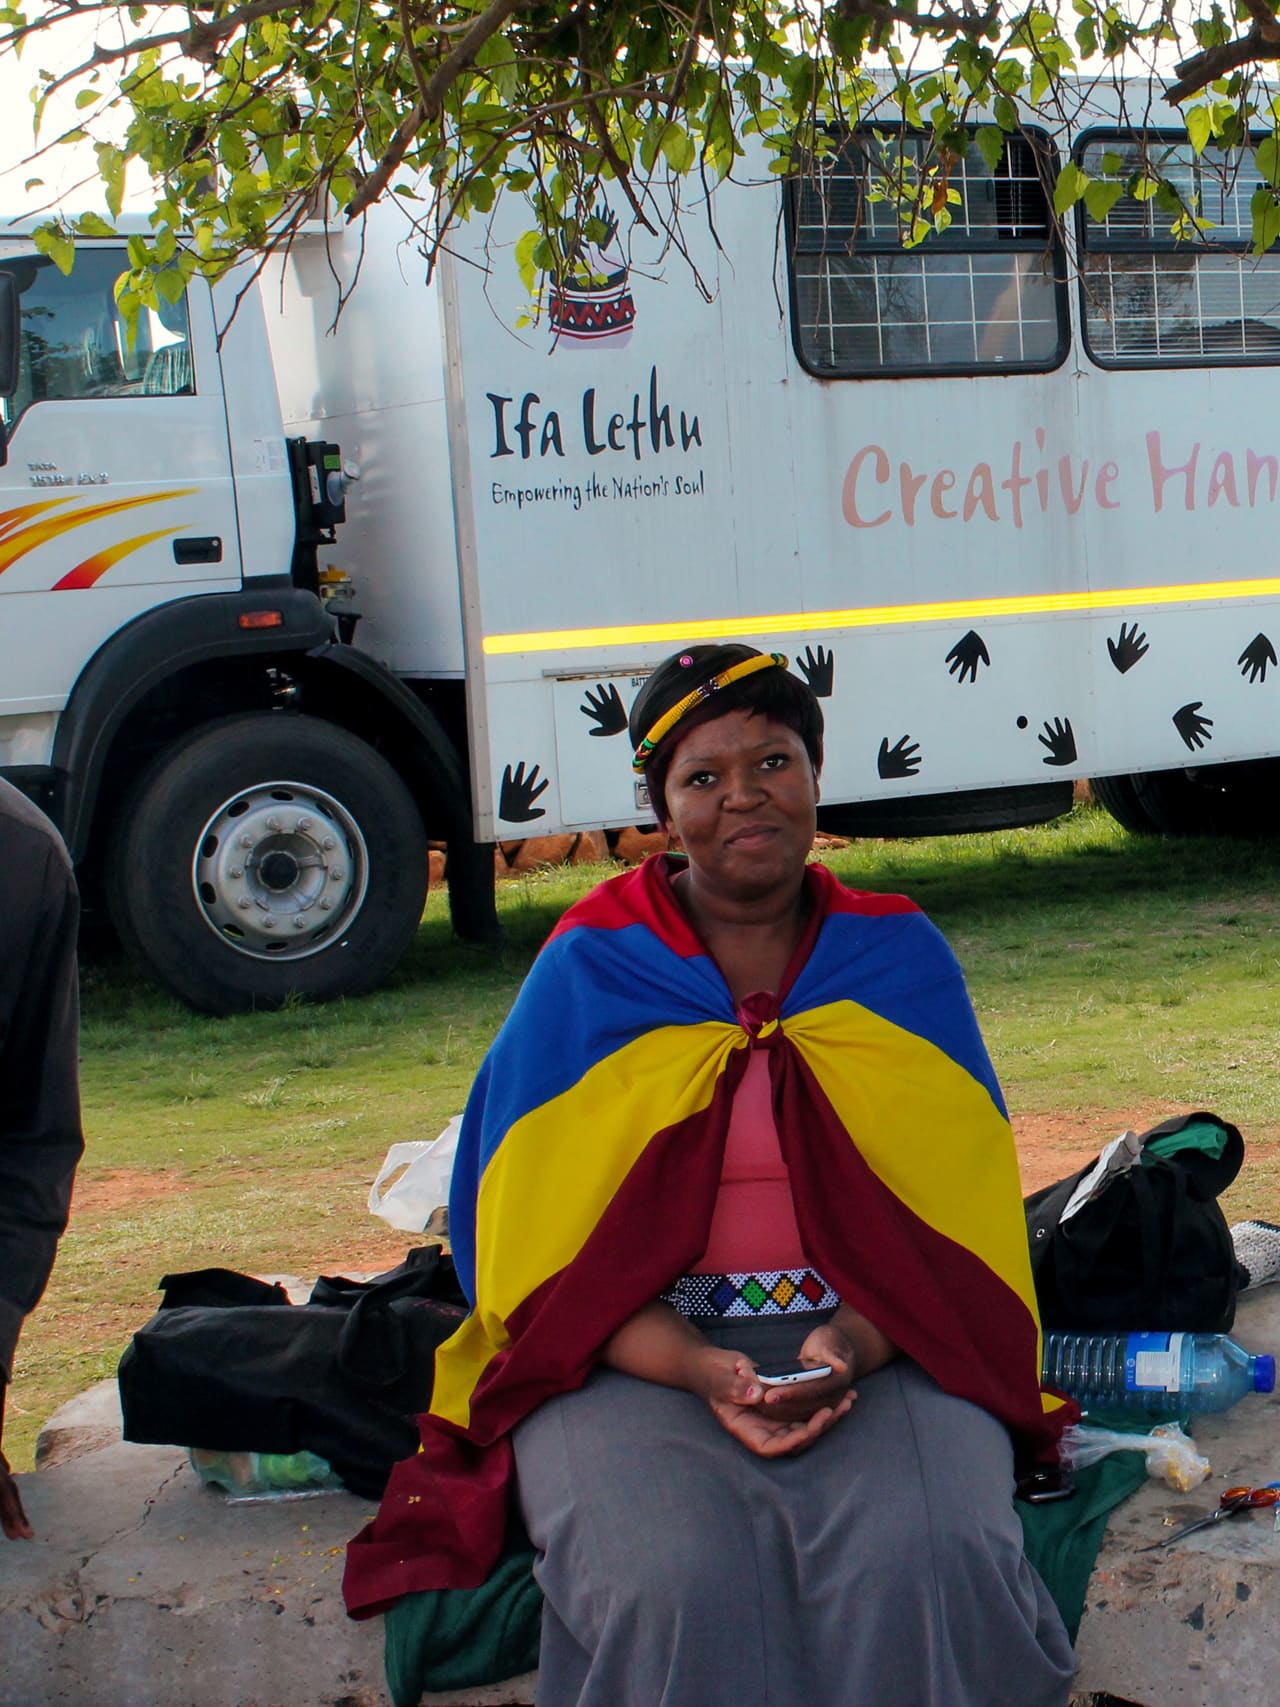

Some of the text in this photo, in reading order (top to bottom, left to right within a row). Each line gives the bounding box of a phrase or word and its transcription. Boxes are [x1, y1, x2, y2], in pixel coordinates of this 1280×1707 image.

[486, 364, 702, 461] Ifa Lethu
[491, 469, 705, 510] Empowering the Nation's Soul
[841, 427, 1121, 529] Creative
